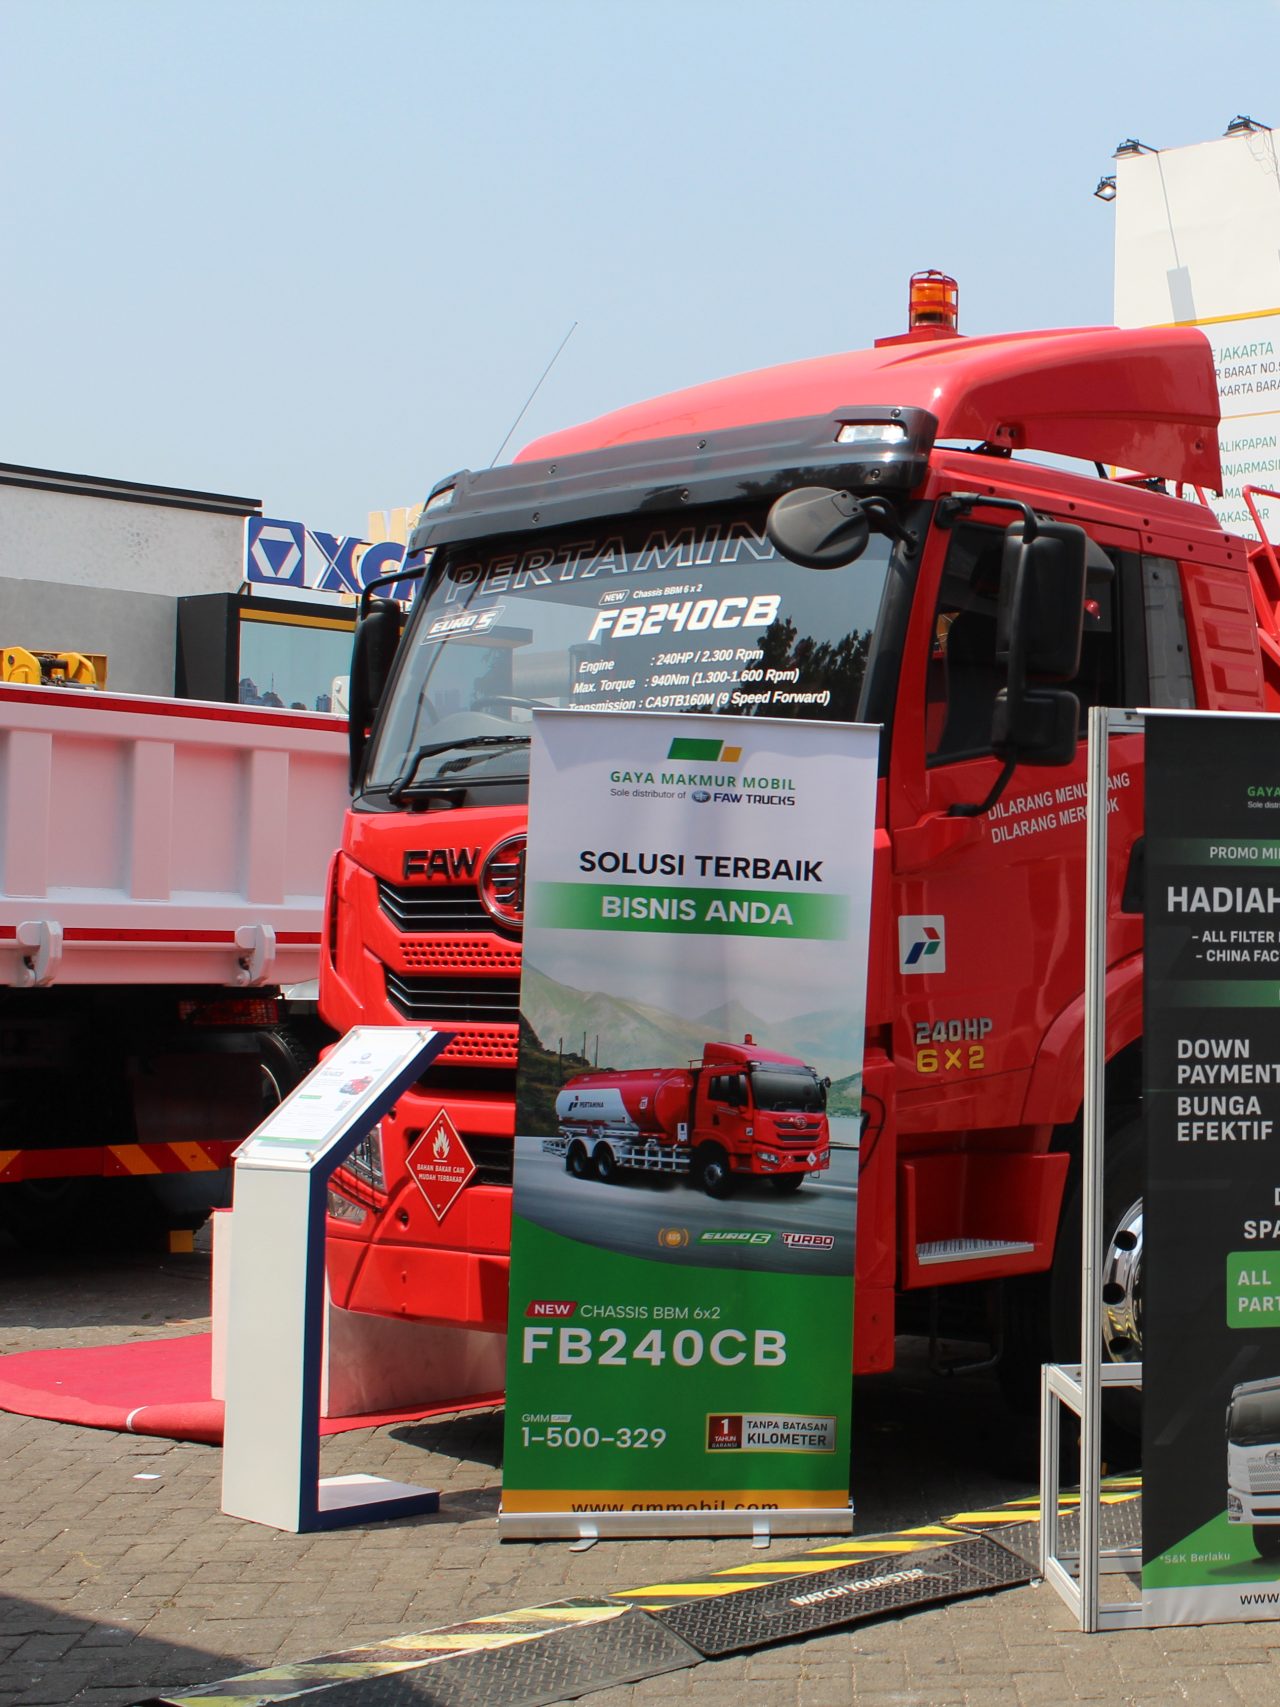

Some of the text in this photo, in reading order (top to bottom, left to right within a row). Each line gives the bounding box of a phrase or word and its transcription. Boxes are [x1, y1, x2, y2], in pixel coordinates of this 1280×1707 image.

[1219, 341, 1274, 364] JAKARTA
[1224, 363, 1257, 379] BARAT
[1219, 382, 1254, 397] KARTA
[1218, 435, 1277, 453] ALIKPAPAN
[445, 521, 776, 604] PERTAMIN
[603, 591, 626, 603] NEW
[632, 587, 662, 599] Chassis
[663, 585, 682, 596] BBM
[430, 615, 476, 634] EURO
[588, 594, 781, 641] FB240CB
[579, 659, 615, 675] Engine
[656, 651, 693, 666] 240HP
[701, 648, 733, 663] 2.300
[735, 648, 764, 663] Rpm
[573, 681, 597, 694] Max.
[599, 678, 635, 694] Torque
[650, 673, 689, 688] 940Nm
[765, 667, 800, 683] Rpm)
[645, 692, 715, 708] CA9TB160M
[731, 691, 770, 707] Speed
[772, 689, 830, 707] Forward)
[610, 770, 796, 791] GAYA MAKMUR MOBIL
[610, 788, 796, 806] Sole distributor of FAW TRUCKS
[988, 791, 1053, 820] DILARANG
[1247, 801, 1263, 809] Sole
[991, 813, 1057, 844] DILARANG
[1209, 846, 1259, 860] PROMO
[403, 846, 481, 880] FAW
[579, 850, 823, 882] SOLUSI TERBAIK
[602, 896, 794, 926] BISNIS ANDA
[1203, 931, 1227, 943] ALL
[1230, 931, 1275, 944] FILTER
[1206, 950, 1250, 962] CHINA
[916, 1017, 993, 1045] 240HP
[1177, 1039, 1250, 1058] DOWN
[1177, 1096, 1261, 1116] BUNGA
[1177, 1121, 1273, 1141] EFEKTIF
[702, 1232, 750, 1241] EURO
[782, 1232, 833, 1246] TURBO
[1238, 1271, 1272, 1286] ALL
[534, 1303, 721, 1320] NEW CHASSIS BBM 6x2
[522, 1326, 787, 1366] FB240CB
[521, 1413, 550, 1423] GMM
[720, 1418, 729, 1435] 1
[747, 1420, 828, 1432] TANPA BATASAN
[521, 1426, 666, 1448] 1-500-329
[747, 1433, 827, 1446] KILOMETER
[1190, 1551, 1231, 1564] Berlaku
[790, 1585, 849, 1606] WATCH
[844, 1575, 885, 1592] YOUR
